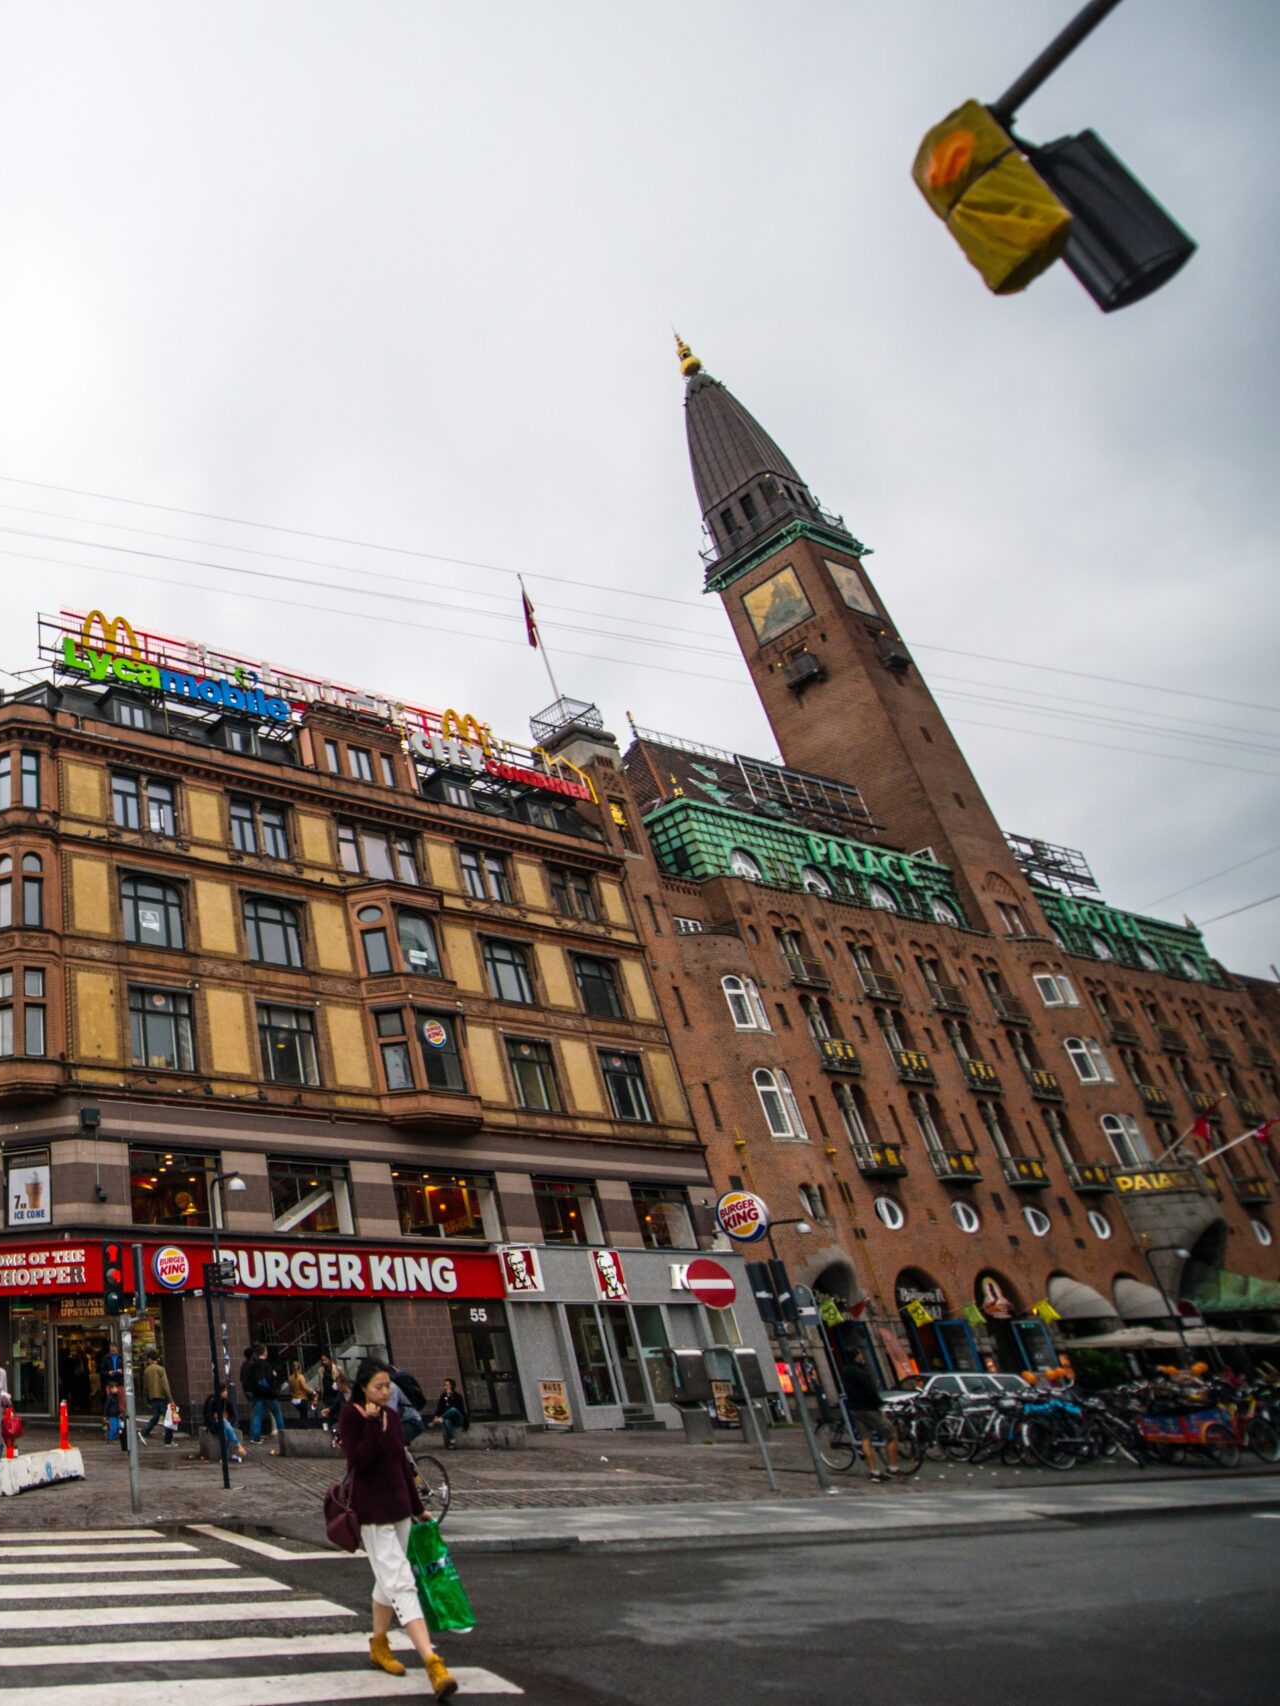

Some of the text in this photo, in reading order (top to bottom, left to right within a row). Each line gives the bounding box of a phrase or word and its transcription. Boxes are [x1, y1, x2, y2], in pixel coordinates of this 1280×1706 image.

[411, 732, 484, 771] CITY
[806, 835, 1147, 943] PALACE HOTEL
[14, 1209, 45, 1220] ICE CONE
[720, 1199, 756, 1219] BURGER
[723, 1208, 759, 1231] KING
[28, 1251, 49, 1265] OF
[52, 1249, 86, 1264] THE
[160, 1256, 185, 1266] BURGER
[160, 1264, 186, 1276] KING
[213, 1249, 365, 1290] BURGER
[371, 1254, 457, 1293] KING
[61, 1299, 104, 1308] 120 SEATS
[61, 1307, 104, 1316] UPSTAIRS
[470, 1309, 487, 1322] 55
